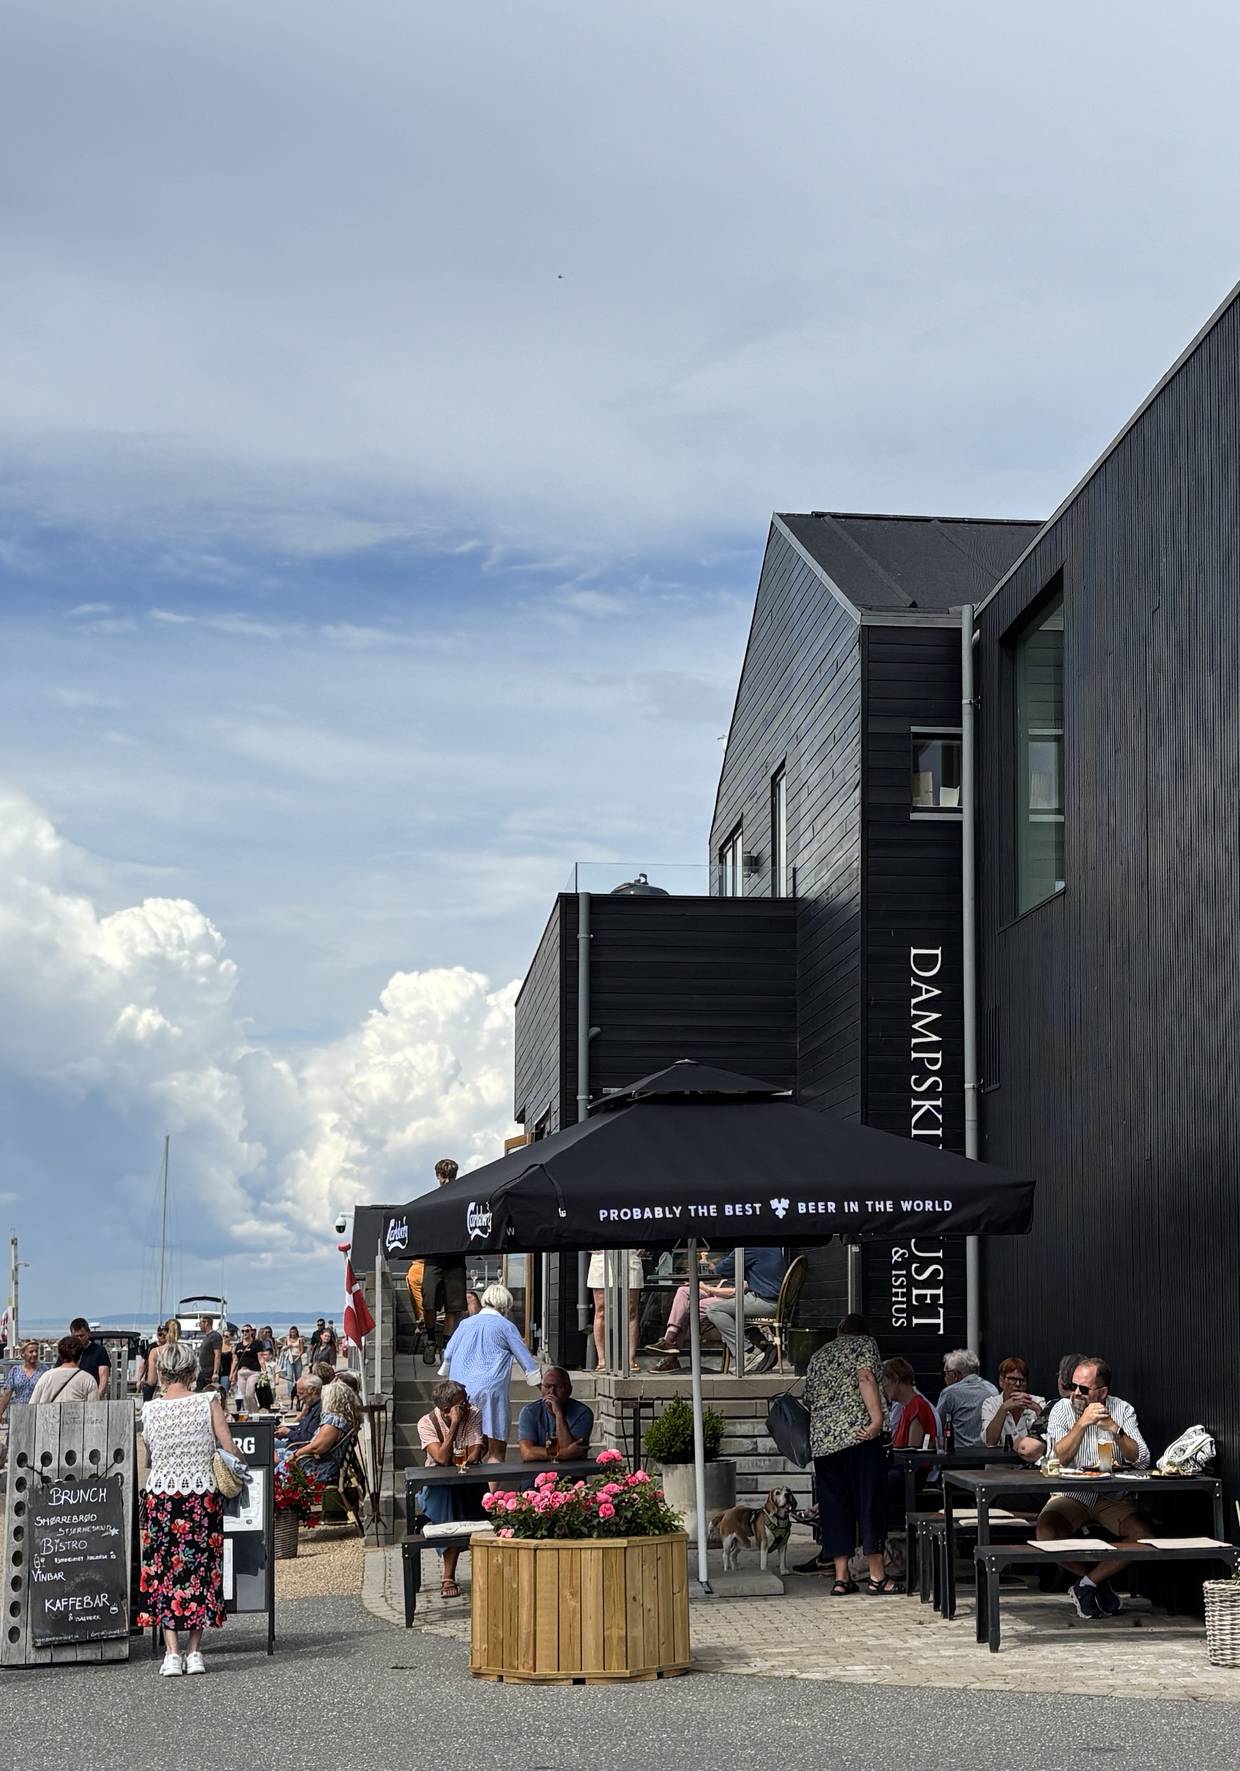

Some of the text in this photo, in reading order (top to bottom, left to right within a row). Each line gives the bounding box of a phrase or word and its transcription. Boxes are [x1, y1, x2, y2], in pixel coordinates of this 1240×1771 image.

[599, 1200, 953, 1222] PROBABLY THE BEST BEER IN THE WORLD
[891, 1247, 908, 1328] & ISHUS
[48, 1487, 107, 1506] BRUNCH
[34, 1513, 97, 1527] SMØRREBRØD
[45, 1593, 110, 1613] KAFFEBAR
